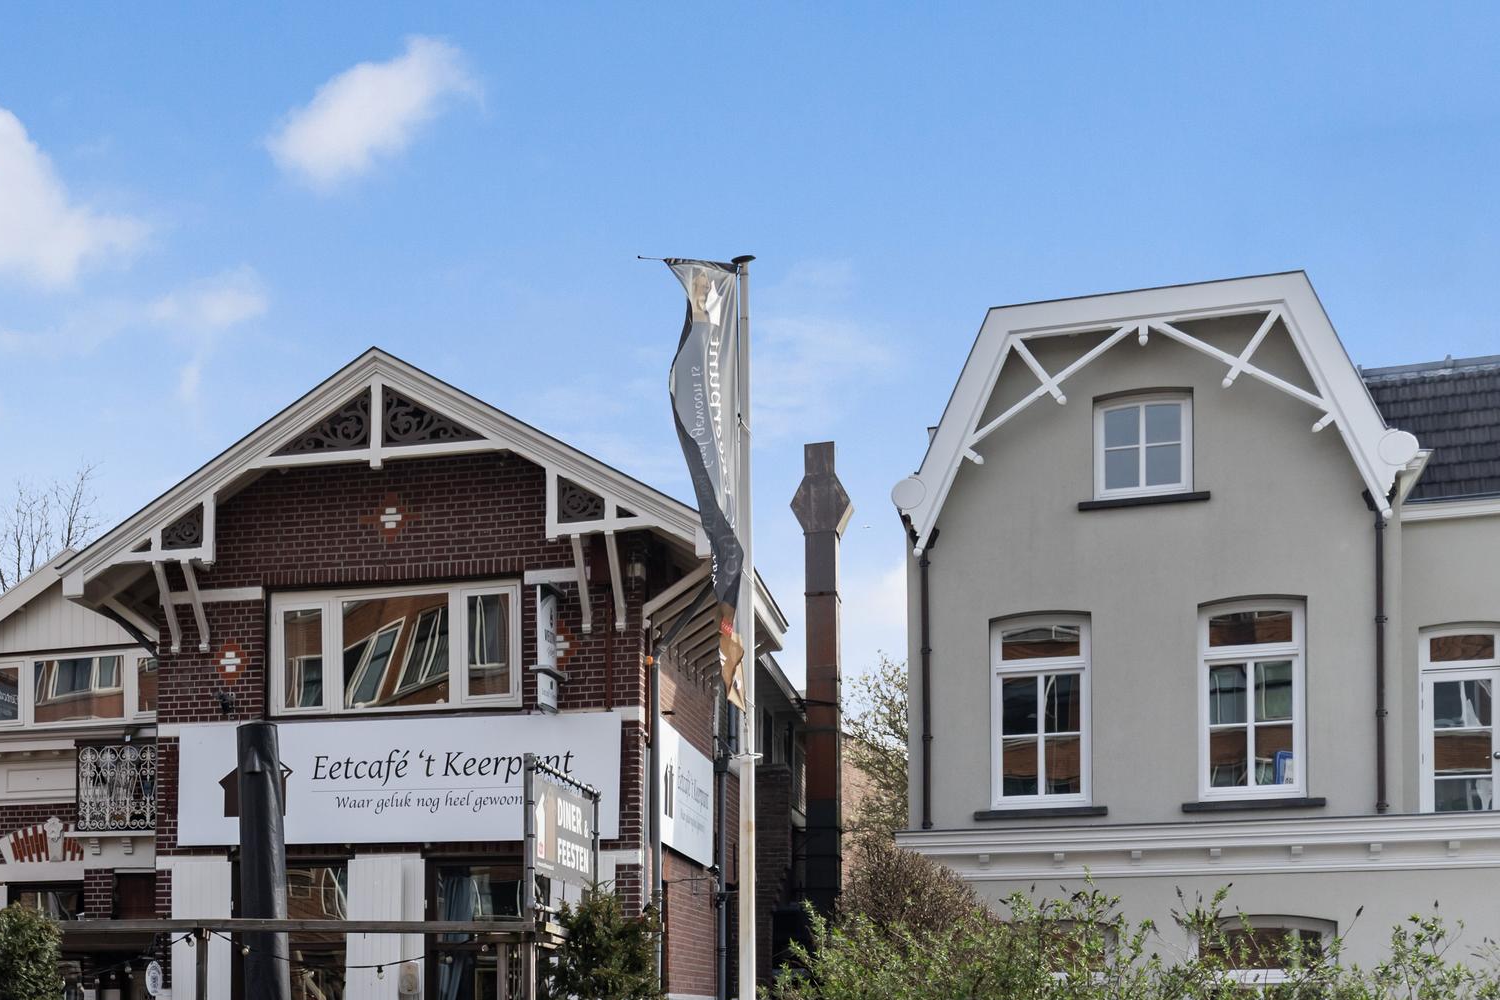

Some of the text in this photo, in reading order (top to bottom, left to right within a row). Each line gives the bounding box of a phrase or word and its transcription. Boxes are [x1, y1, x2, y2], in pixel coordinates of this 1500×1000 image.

[311, 749, 410, 786] Eetcafé
[442, 750, 574, 784] Keerpnt
[334, 790, 524, 815] Waar geluk nog heel gewoon
[557, 797, 589, 838] DINER &
[557, 838, 589, 874] FEESTEN
